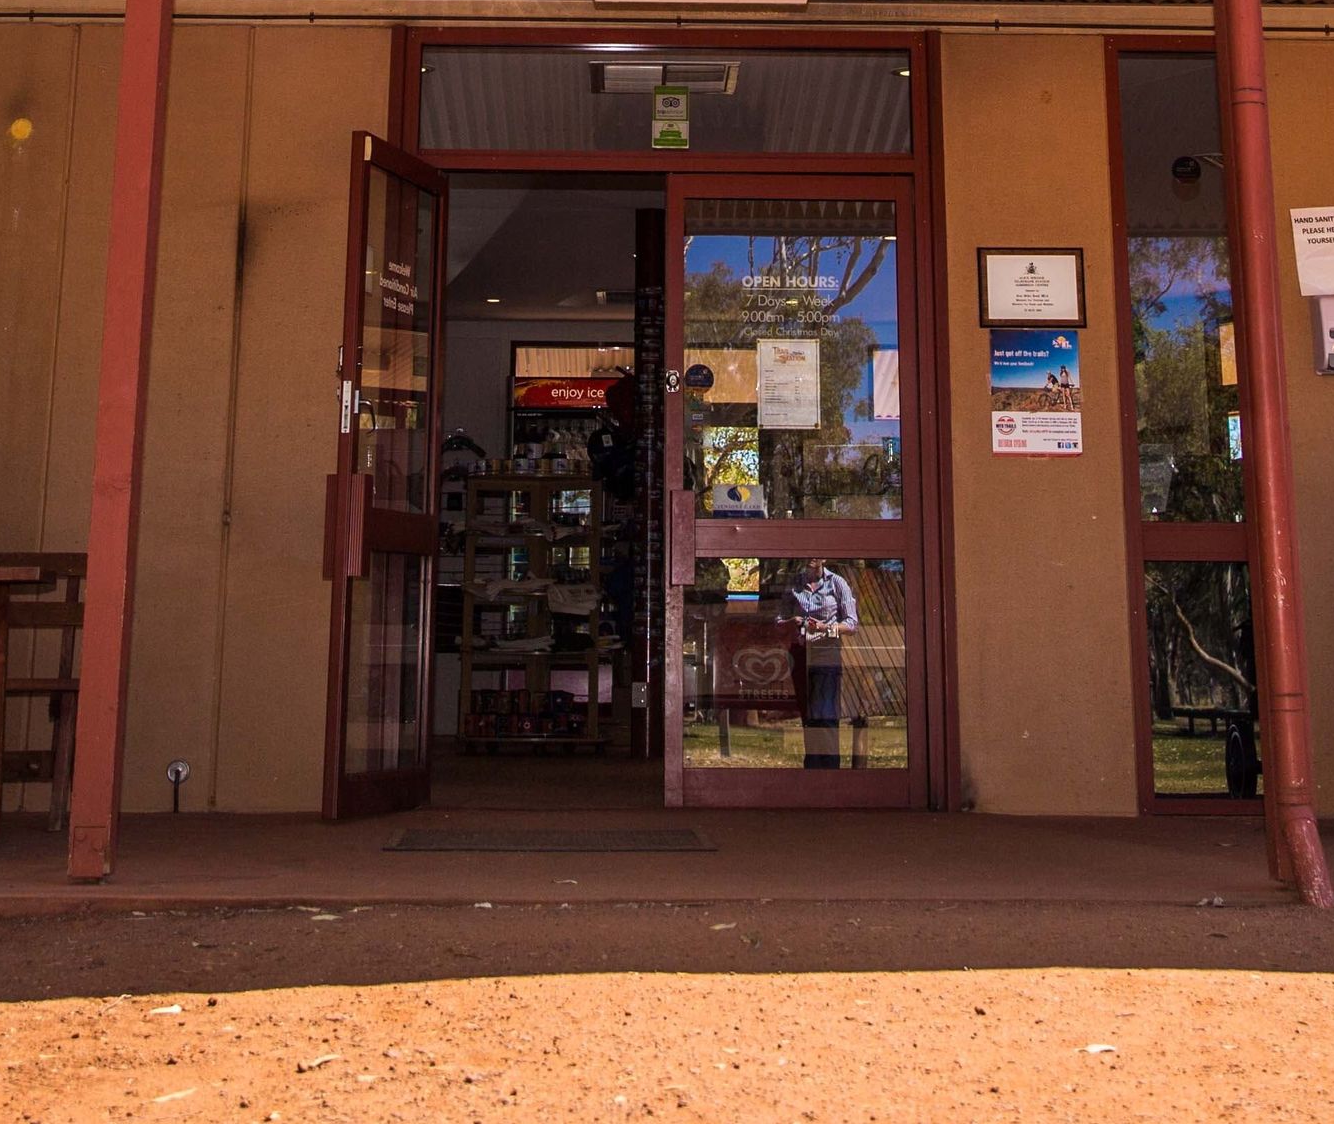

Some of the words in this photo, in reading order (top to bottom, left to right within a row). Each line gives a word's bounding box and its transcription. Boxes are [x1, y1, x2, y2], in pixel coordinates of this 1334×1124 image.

[1294, 216, 1314, 224] HAND
[741, 276, 781, 288] OPEN
[786, 276, 839, 288] HOURS:
[747, 295, 753, 306] 7
[758, 295, 787, 309] Days
[802, 295, 834, 307] Week
[743, 327, 772, 336] Closed
[776, 327, 817, 336] Christmas
[820, 327, 837, 338] Day
[551, 386, 584, 399] enjoy
[587, 387, 605, 397] ice
[738, 689, 789, 700] STREETS
